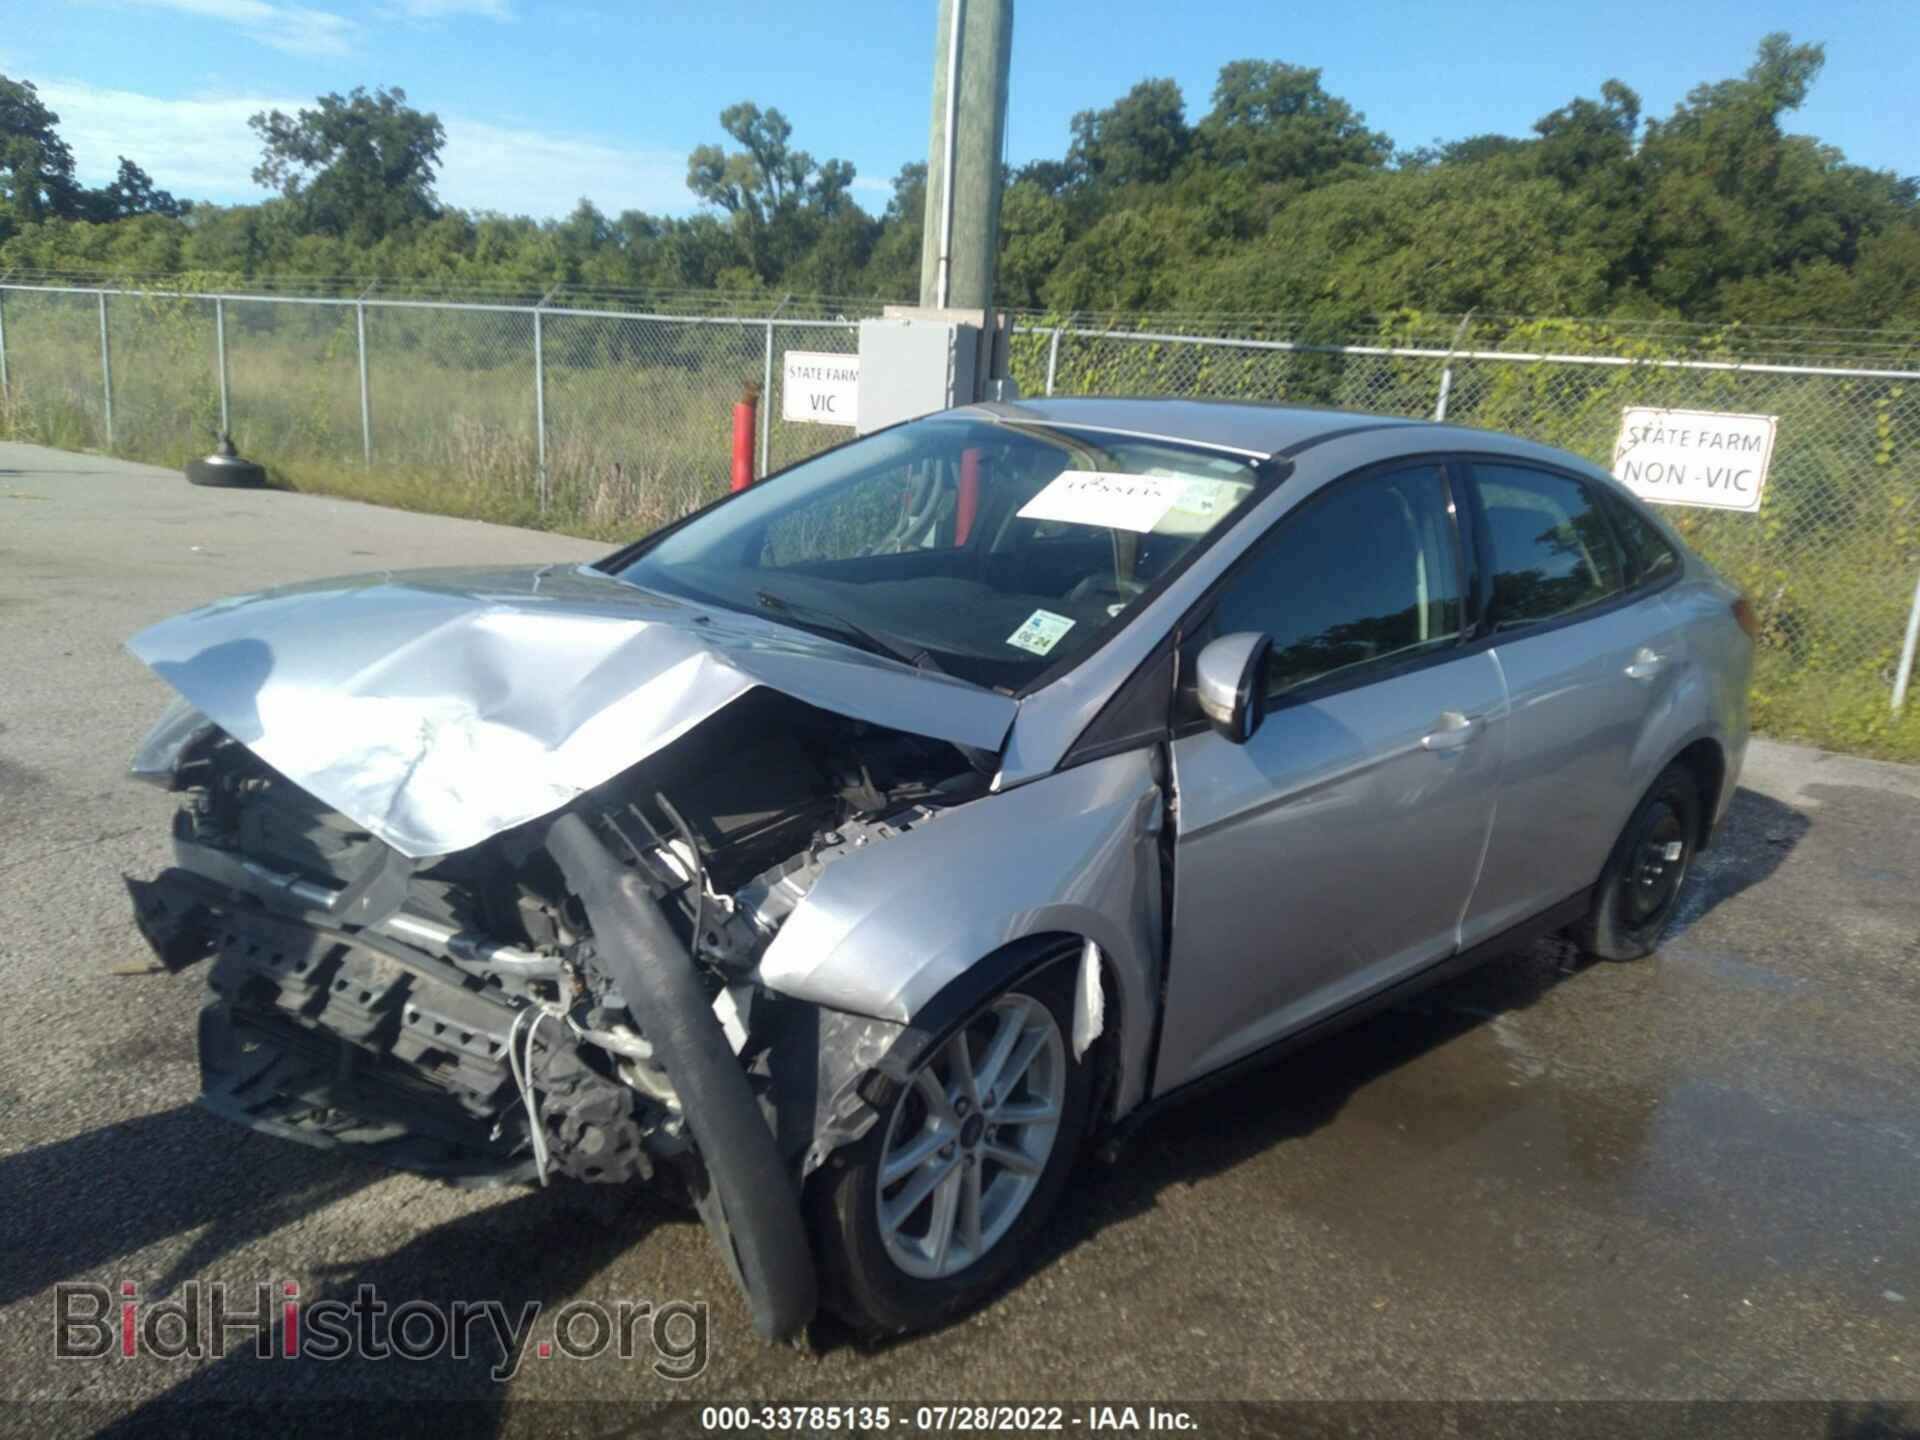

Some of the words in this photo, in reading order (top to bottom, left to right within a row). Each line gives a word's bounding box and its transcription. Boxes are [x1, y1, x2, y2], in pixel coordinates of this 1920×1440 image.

[789, 365, 823, 381] STATE
[810, 393, 837, 413] VIC
[1627, 425, 1691, 448] STATE
[1699, 431, 1762, 453] FARM
